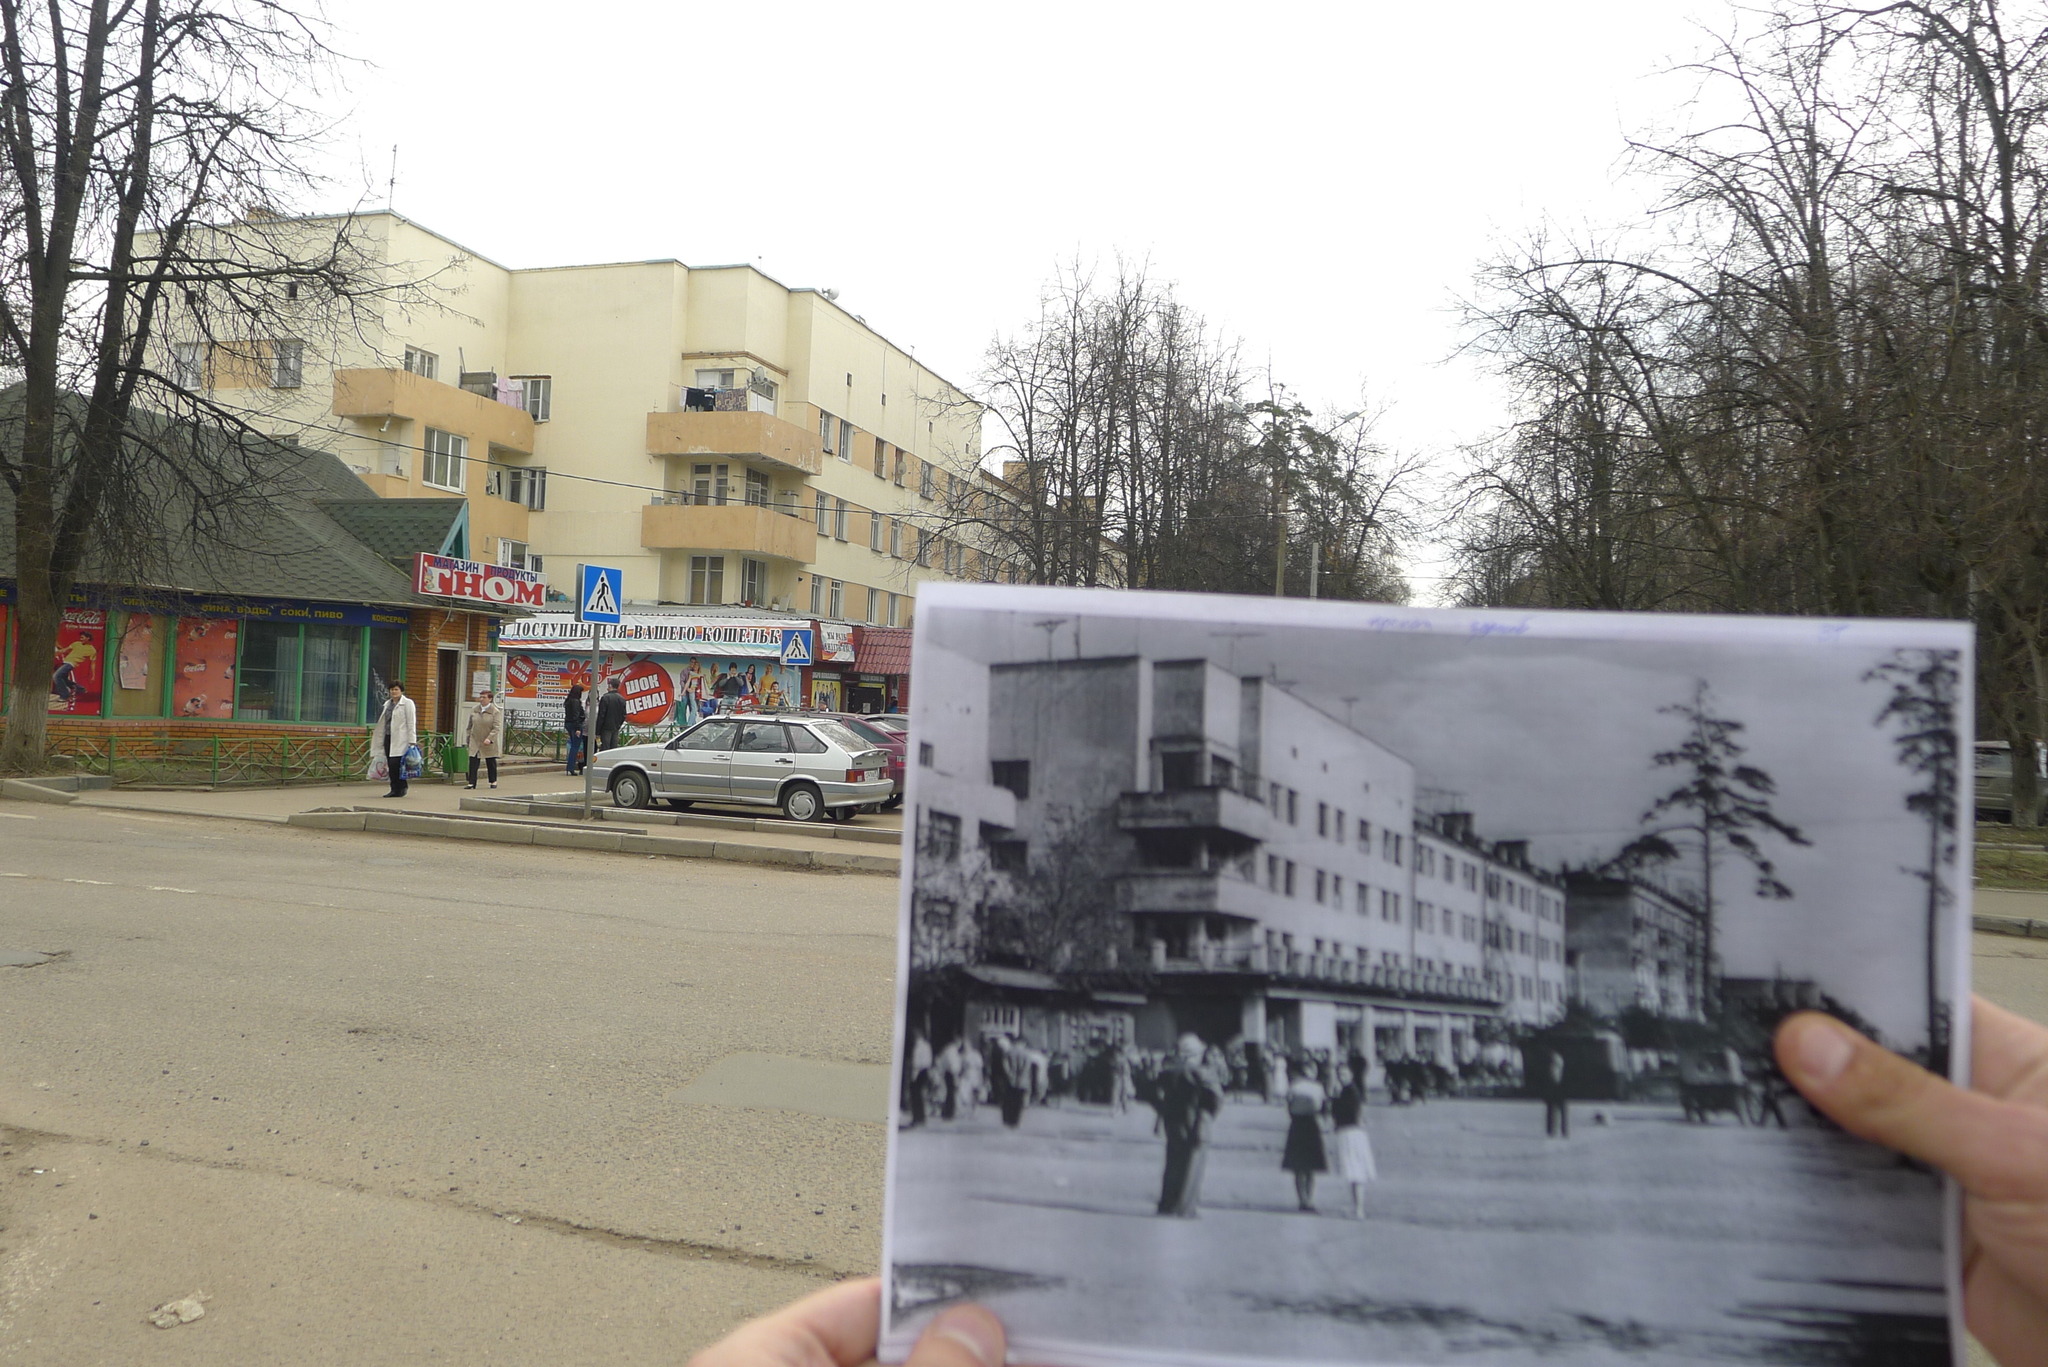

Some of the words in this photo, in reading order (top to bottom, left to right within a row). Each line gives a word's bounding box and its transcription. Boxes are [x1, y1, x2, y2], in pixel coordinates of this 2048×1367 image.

[434, 557, 479, 574] МАГАЗИН
[490, 565, 538, 583] ПРОДУКТЫ
[430, 566, 544, 606] ГНОМ
[236, 606, 272, 616] ВОДЫ,
[280, 607, 311, 618] СОКИ,
[314, 609, 344, 619] ПИВО
[371, 613, 408, 624] КОНСЕРВЫ
[512, 622, 592, 638] ДОСТУПНЫ
[634, 625, 697, 642] ВАШЕГО
[702, 626, 781, 645] КОШЕЛЬК
[514, 659, 532, 675] ШОК
[625, 673, 660, 695] ШОК
[625, 690, 667, 715] ЦЕНА!
